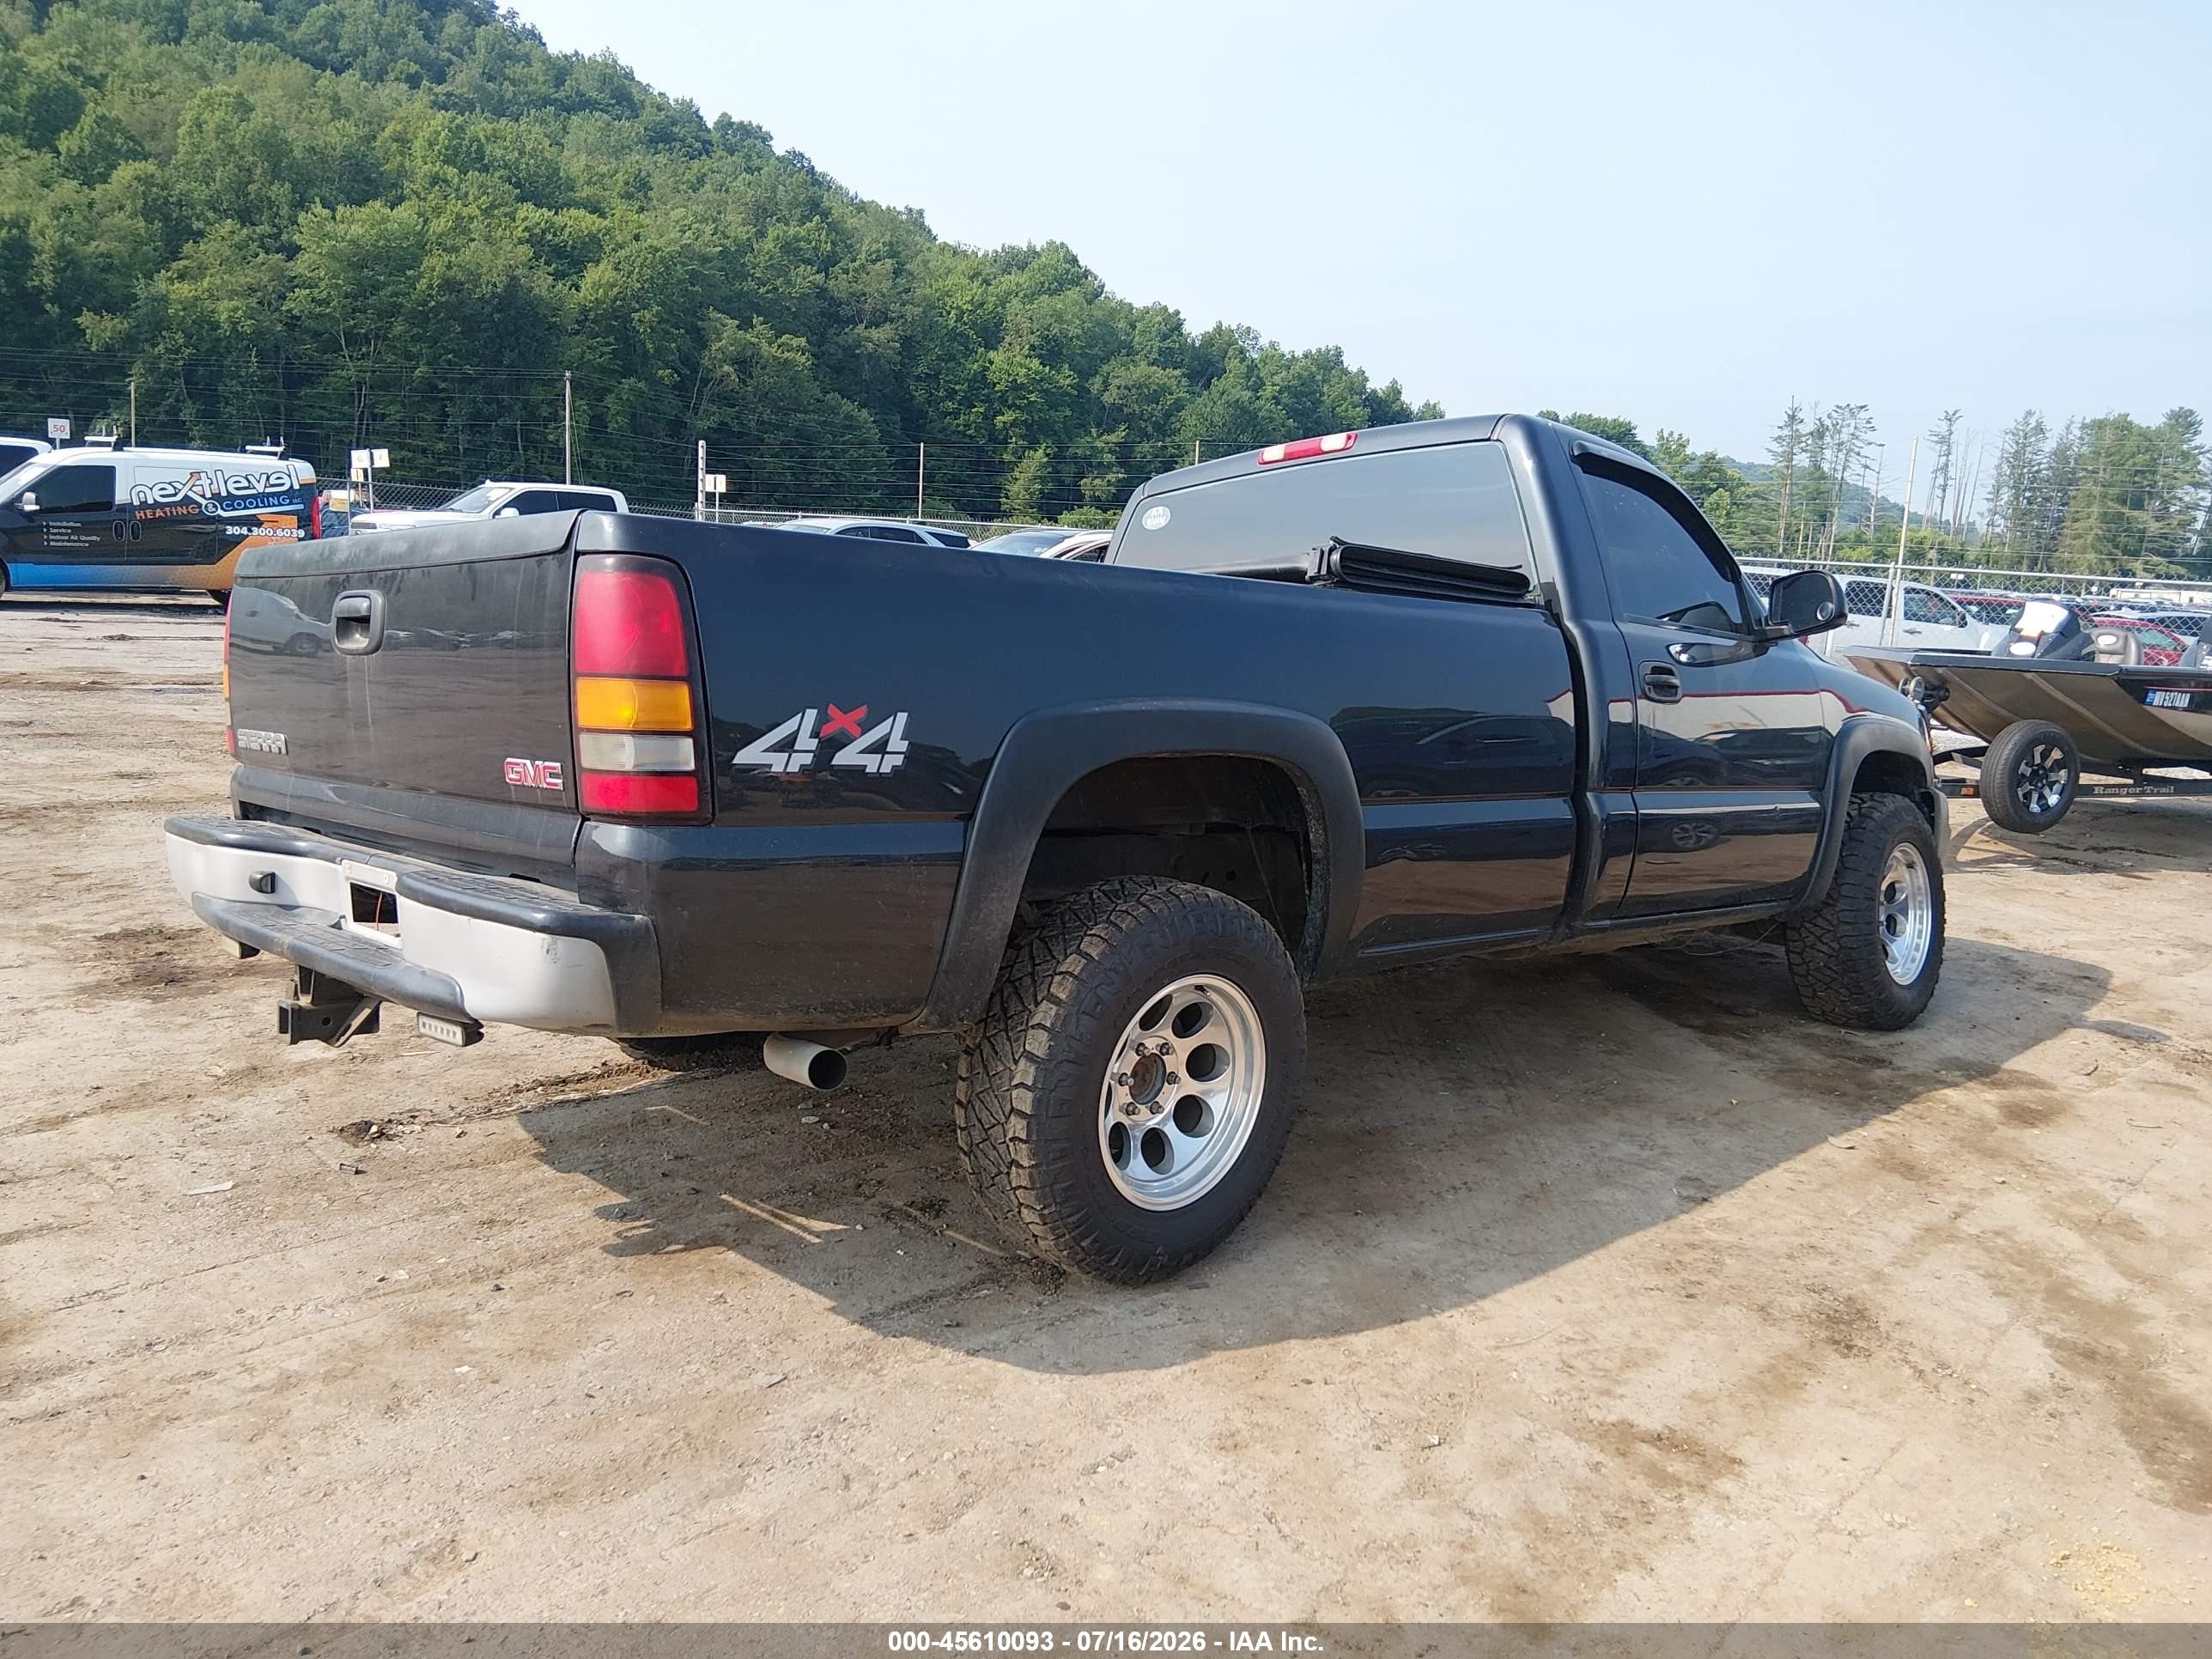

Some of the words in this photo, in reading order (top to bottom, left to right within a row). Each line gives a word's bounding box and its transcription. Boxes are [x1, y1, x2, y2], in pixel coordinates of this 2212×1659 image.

[53, 424, 65, 433] 50
[135, 503, 200, 520] HEATING
[222, 495, 290, 510] COOLING
[225, 526, 305, 538] 304.300.6039
[237, 728, 289, 756] SIERRA
[505, 757, 564, 791] GMC
[2093, 786, 2143, 795] Ranger
